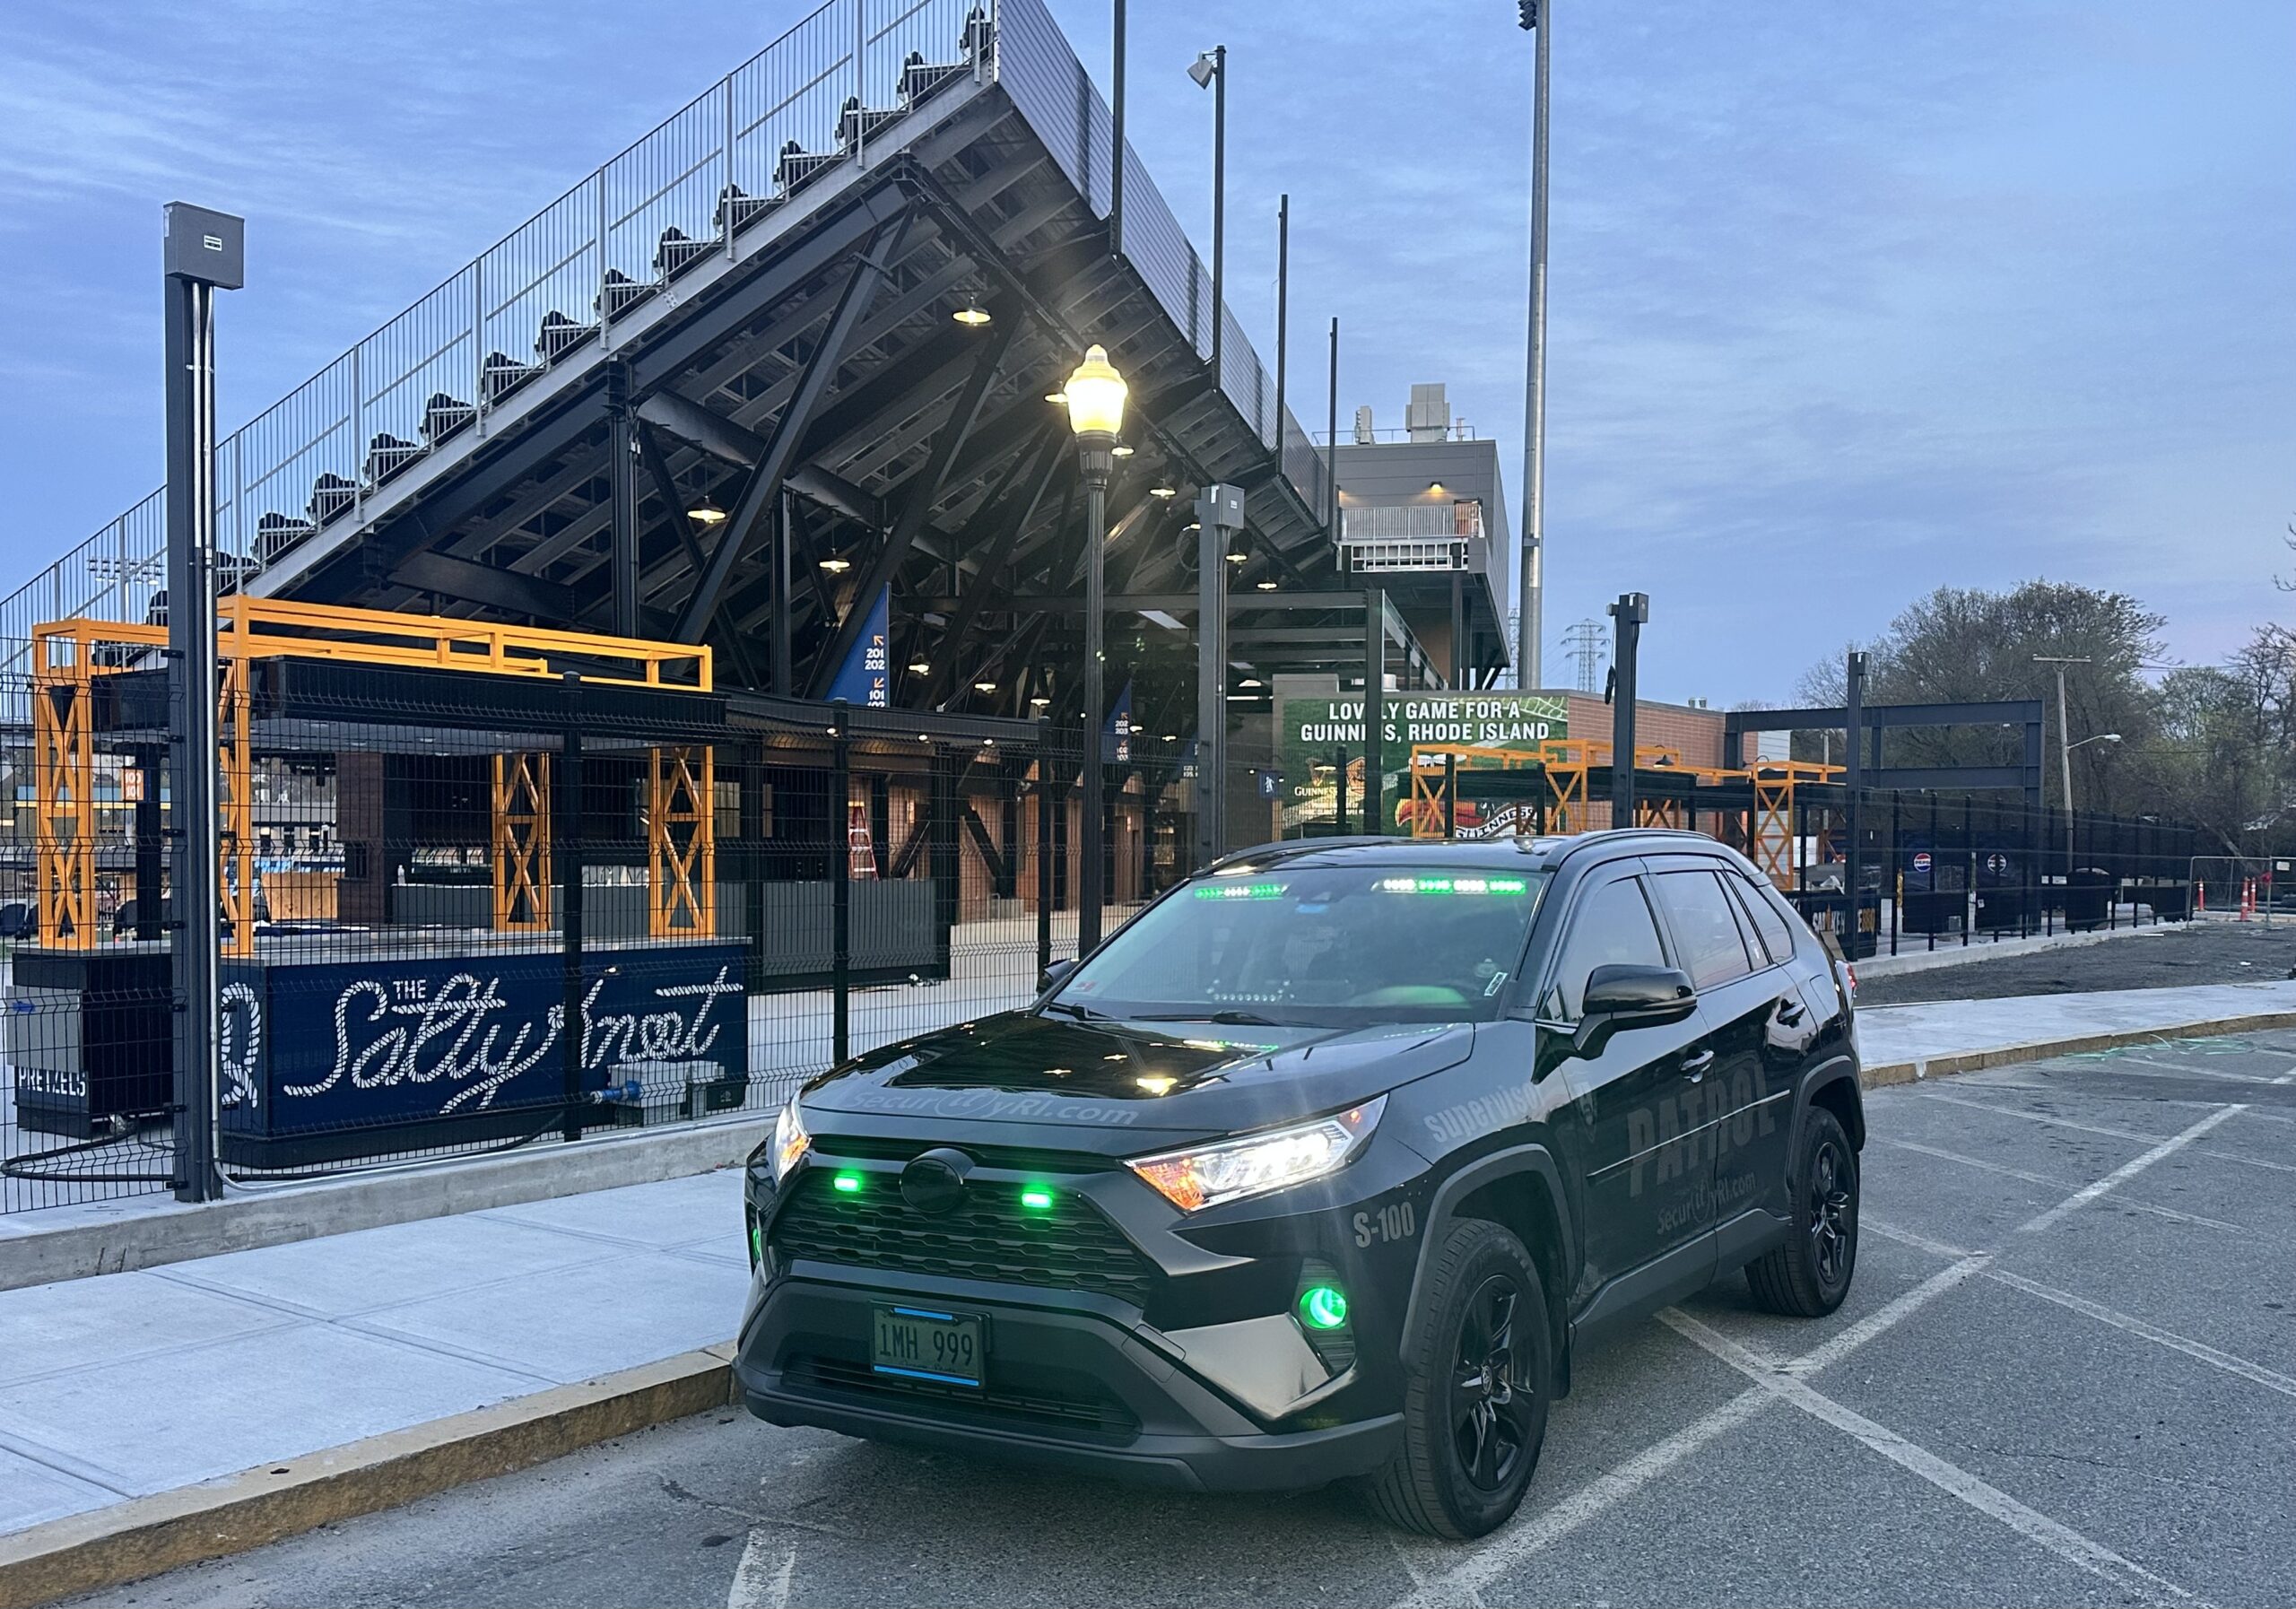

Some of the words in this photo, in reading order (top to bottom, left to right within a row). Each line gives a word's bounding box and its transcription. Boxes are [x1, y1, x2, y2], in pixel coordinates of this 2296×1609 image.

[866, 648, 884, 658] 201
[865, 660, 885, 670] 202
[869, 690, 885, 700] 101
[1329, 702, 1401, 720] LOVY
[1405, 702, 1459, 719] GAME
[1465, 701, 1500, 718] FOR
[1508, 700, 1521, 718] A
[1300, 723, 1402, 744] GUINNS,
[1408, 723, 1472, 741] RHODE
[1479, 722, 1550, 740] ISLAND
[392, 979, 427, 1000] THE
[283, 973, 540, 1115] Salty
[19, 1065, 86, 1098] PRETZELS
[1627, 1062, 1776, 1198] PATROL
[1352, 1202, 1415, 1249] S-100
[933, 1330, 973, 1367] 999
